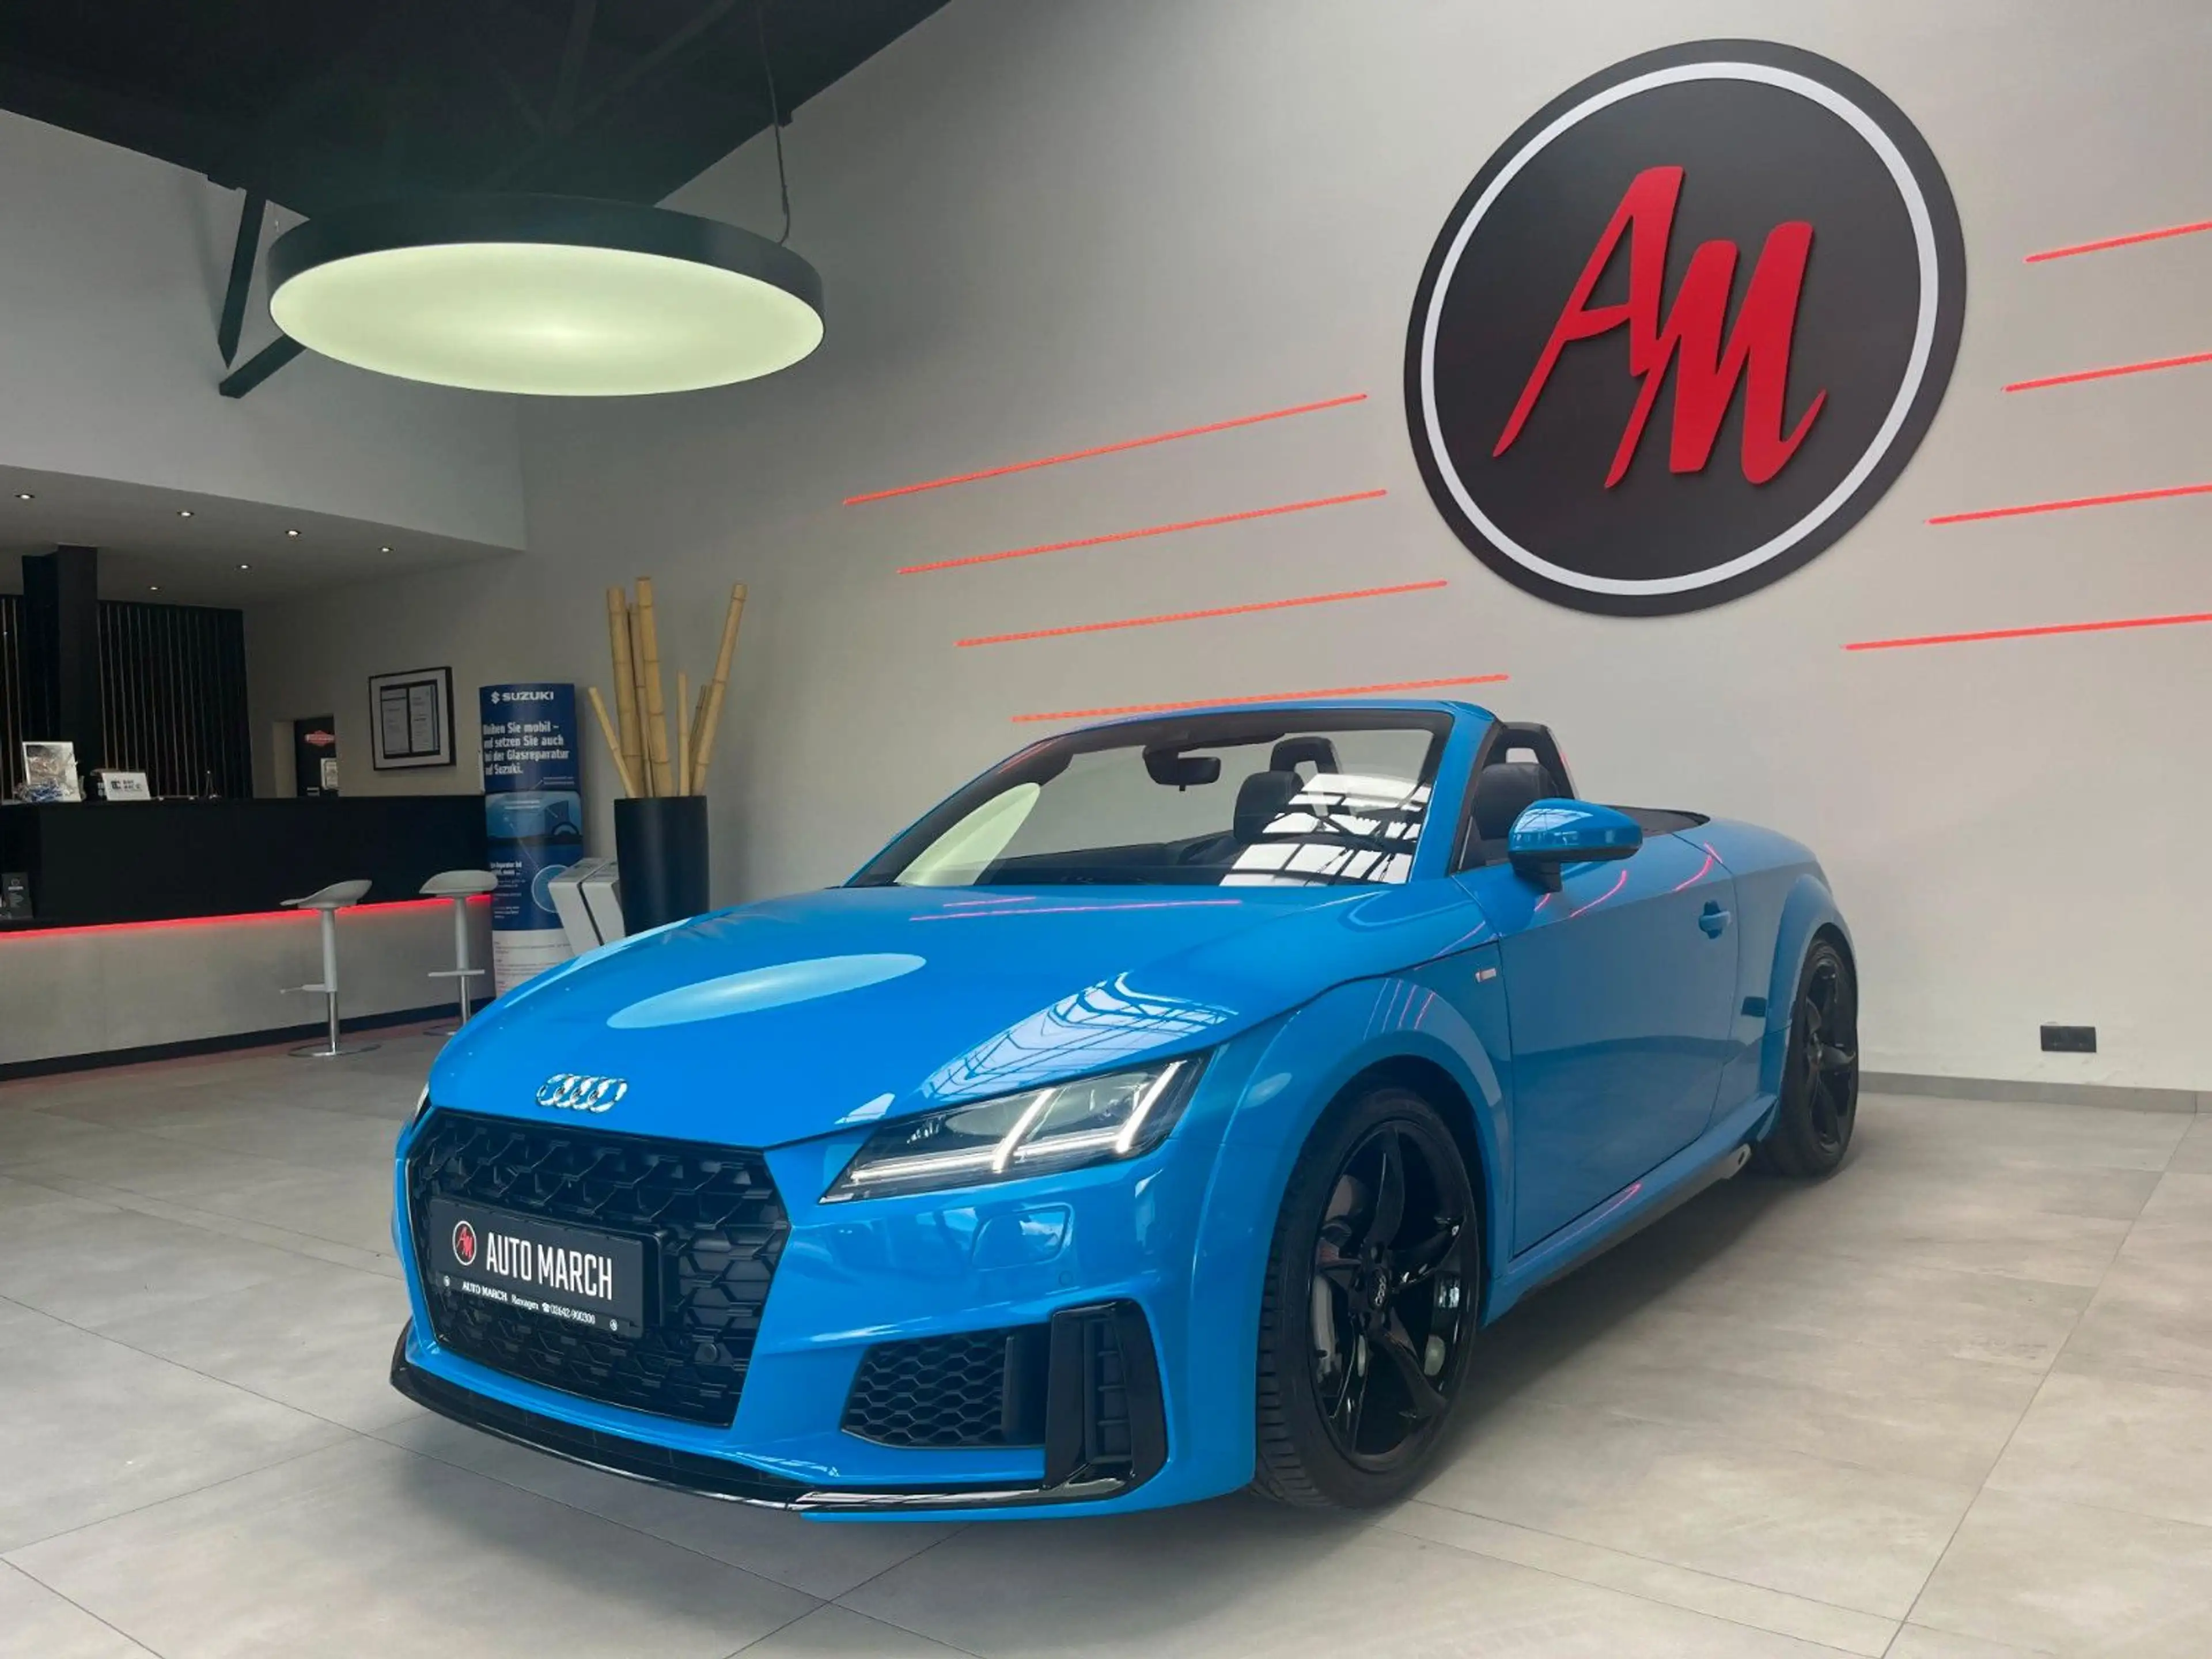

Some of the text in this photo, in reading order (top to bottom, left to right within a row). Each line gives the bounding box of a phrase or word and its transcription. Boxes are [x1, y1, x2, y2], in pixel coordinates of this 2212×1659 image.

[1493, 165, 1827, 490] AM
[502, 691, 555, 701] SUZUKI
[507, 721, 521, 733] Sie
[524, 721, 551, 733] mobil
[495, 736, 521, 748] setzen
[523, 734, 539, 747] Sie
[541, 733, 565, 746] auch
[507, 749, 570, 762] Glasreparatur
[486, 1231, 613, 1301] AUTO MARCH
[462, 1281, 481, 1294] AUTO
